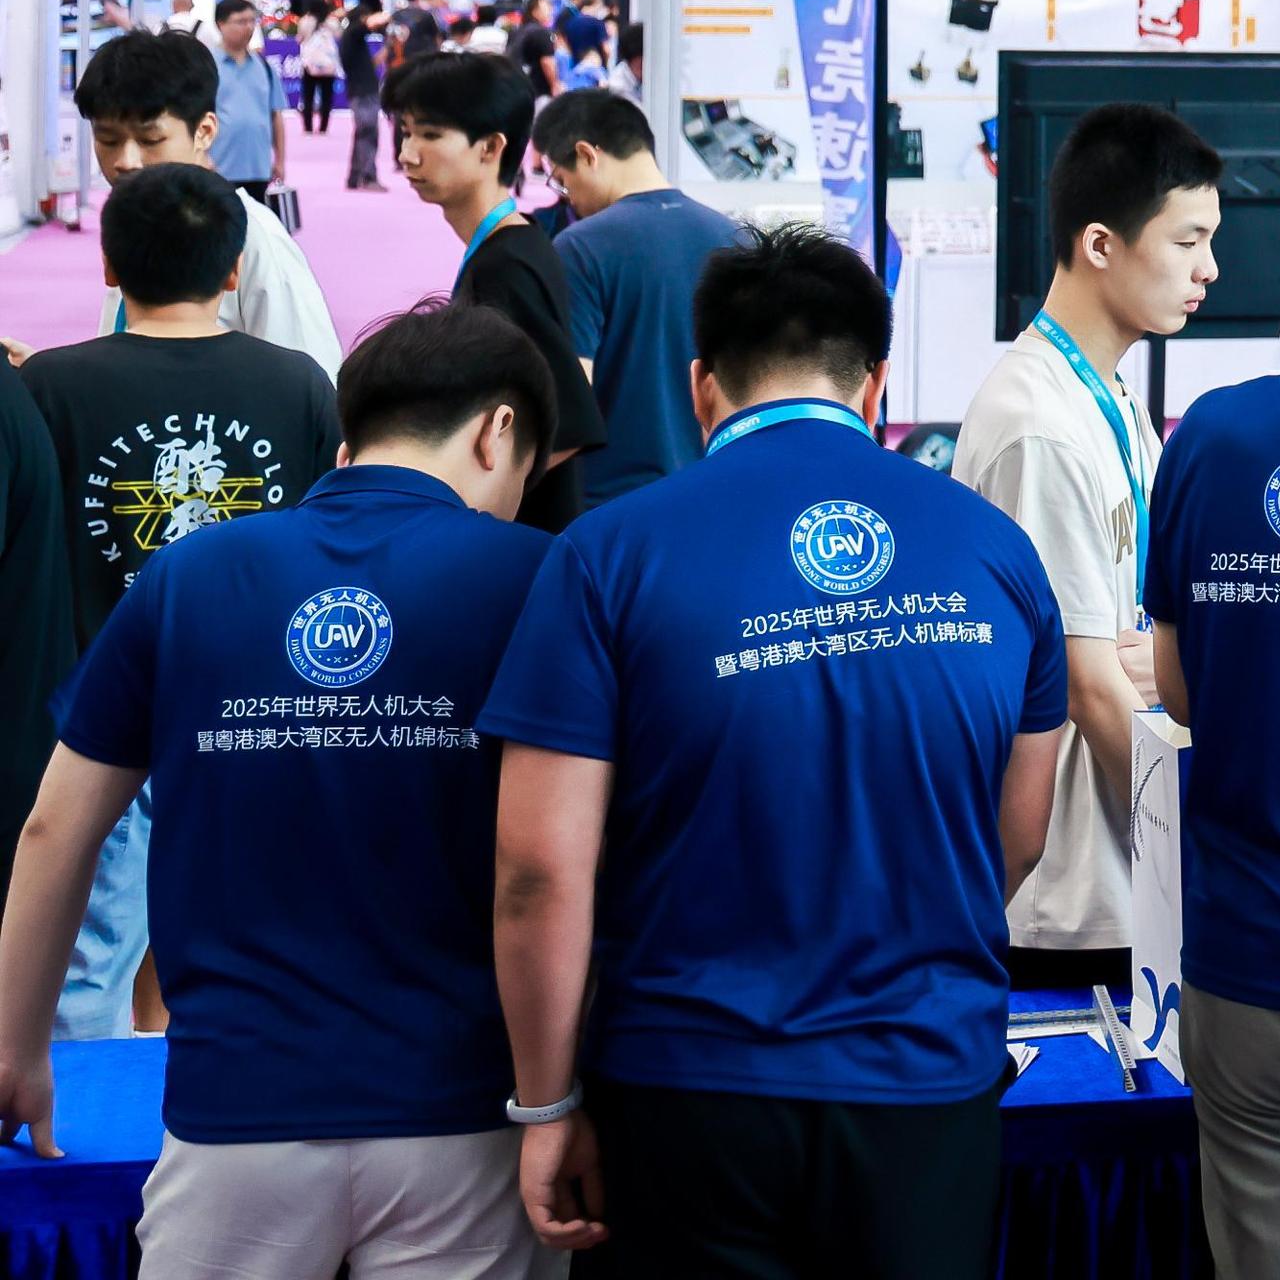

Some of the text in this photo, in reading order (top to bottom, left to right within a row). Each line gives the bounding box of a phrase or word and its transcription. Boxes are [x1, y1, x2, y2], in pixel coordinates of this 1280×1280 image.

[793, 503, 888, 544] 世界无人机大会
[816, 531, 865, 559] UAV
[796, 541, 891, 591] DRONE WORLD CONGRESS
[292, 590, 390, 630] 世界无人机大会
[740, 591, 968, 638] 2025年世界无人机大会
[314, 624, 366, 649] UAV
[714, 621, 994, 678] 暨粤港澳大湾区无人机锦标赛
[290, 637, 388, 684] DRONE WORLD CONGRESS
[221, 695, 455, 718] 2025年世界无人机大会
[196, 725, 481, 752] 暨粤港澳大湾区无人机锦标赛
